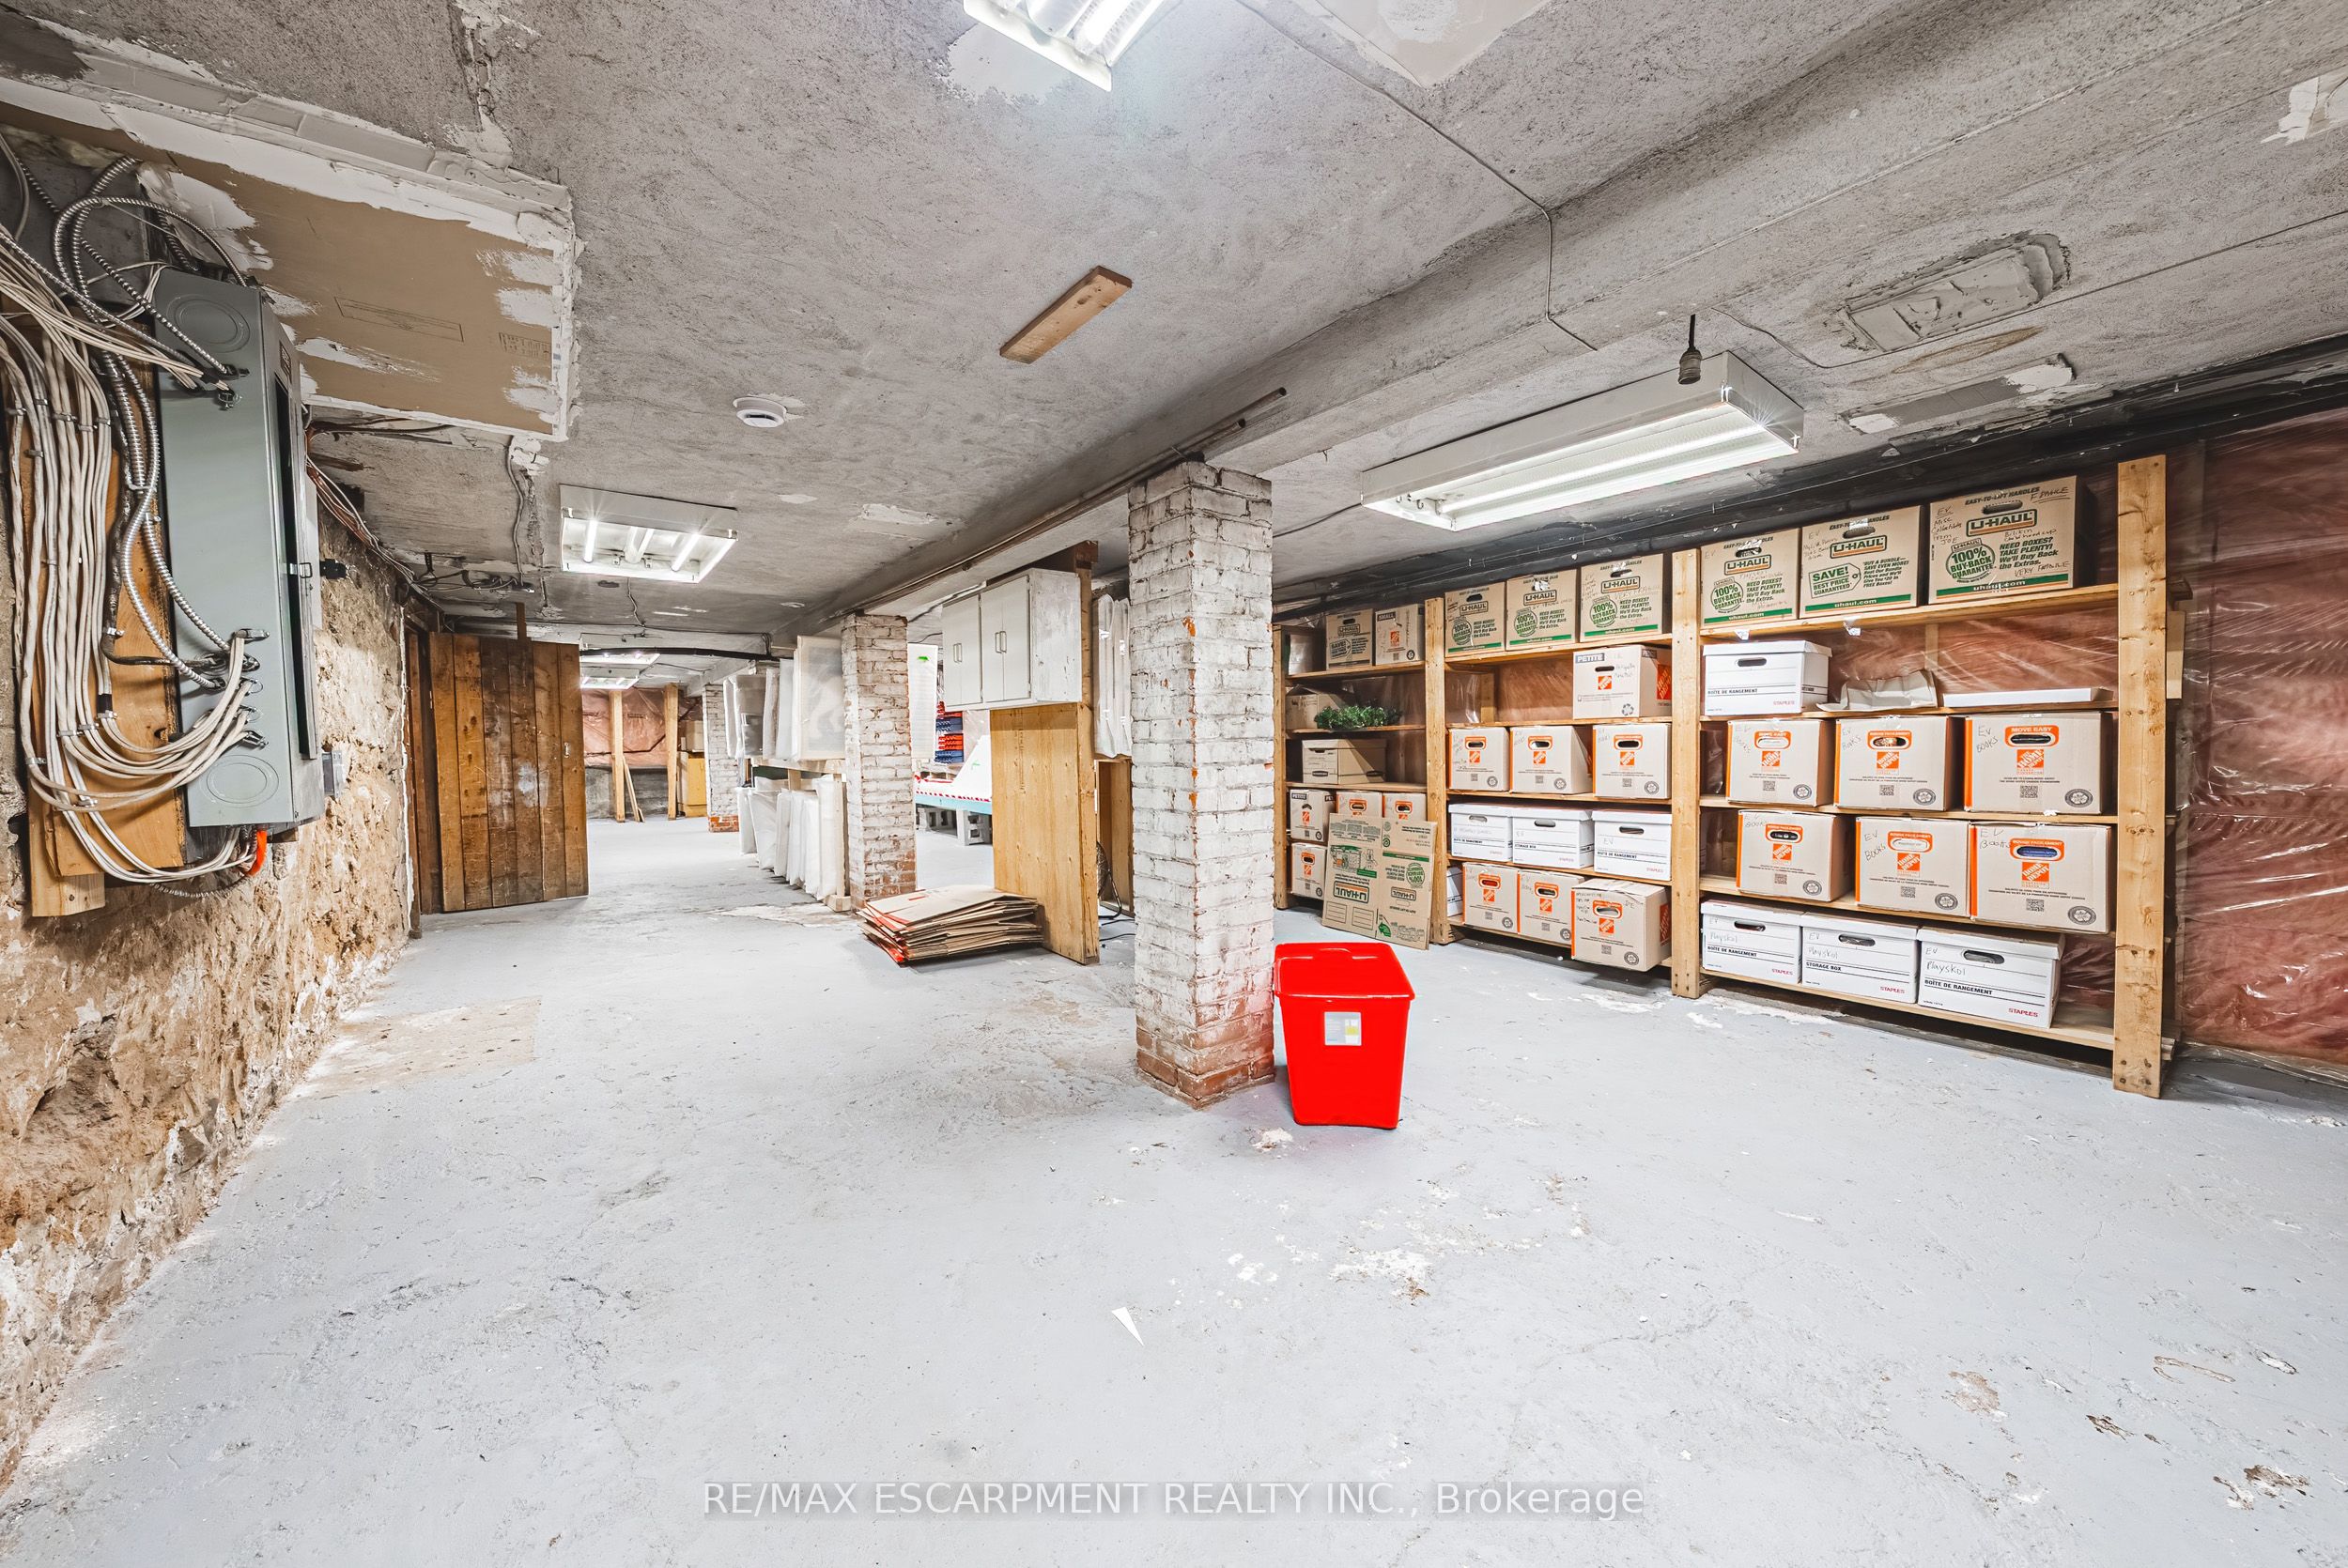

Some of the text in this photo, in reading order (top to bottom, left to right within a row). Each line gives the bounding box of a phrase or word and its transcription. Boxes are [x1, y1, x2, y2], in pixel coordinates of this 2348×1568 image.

[2008, 486, 2040, 498] HANDLES
[1971, 512, 2033, 530] U-HAUL
[1833, 538, 1883, 552] U-HAUL
[1954, 539, 1979, 549] U-HAUL
[2000, 537, 2053, 550] NEED BOXES?
[2020, 544, 2053, 554] PLENTY!
[1952, 546, 1986, 564] 100%
[2037, 549, 2059, 558] Back
[1727, 557, 1769, 569] U-HAUL
[1951, 557, 1992, 572] BUY-BACK
[1813, 566, 1848, 581] SAVE!
[1603, 578, 1638, 589] U-HAUL
[1831, 577, 1849, 587] PRICE
[1525, 592, 1555, 601] U-HAUL
[1714, 584, 1738, 597] 100%
[1714, 592, 1742, 604] BUY-BACK
[1834, 599, 1877, 607] uhaul.com
[1461, 603, 1487, 611] U-HAUL
[1593, 602, 1613, 613] 100%
[1517, 613, 1534, 623] 100%
[1577, 653, 1602, 662] PETITE
[2017, 749, 2044, 768] HOME
[1898, 853, 1914, 866] HOME
[1901, 855, 1921, 870] DEPOT
[2022, 863, 2043, 877] HOME
[2027, 865, 2049, 881] DEPOT
[1336, 886, 1367, 900] U-HAUL
[1393, 890, 1415, 899] U-HAUL
[1924, 978, 1941, 987] BOÎTE
[1954, 984, 1993, 995] RANGEMENT
[2008, 1007, 2039, 1017] STAPLES
